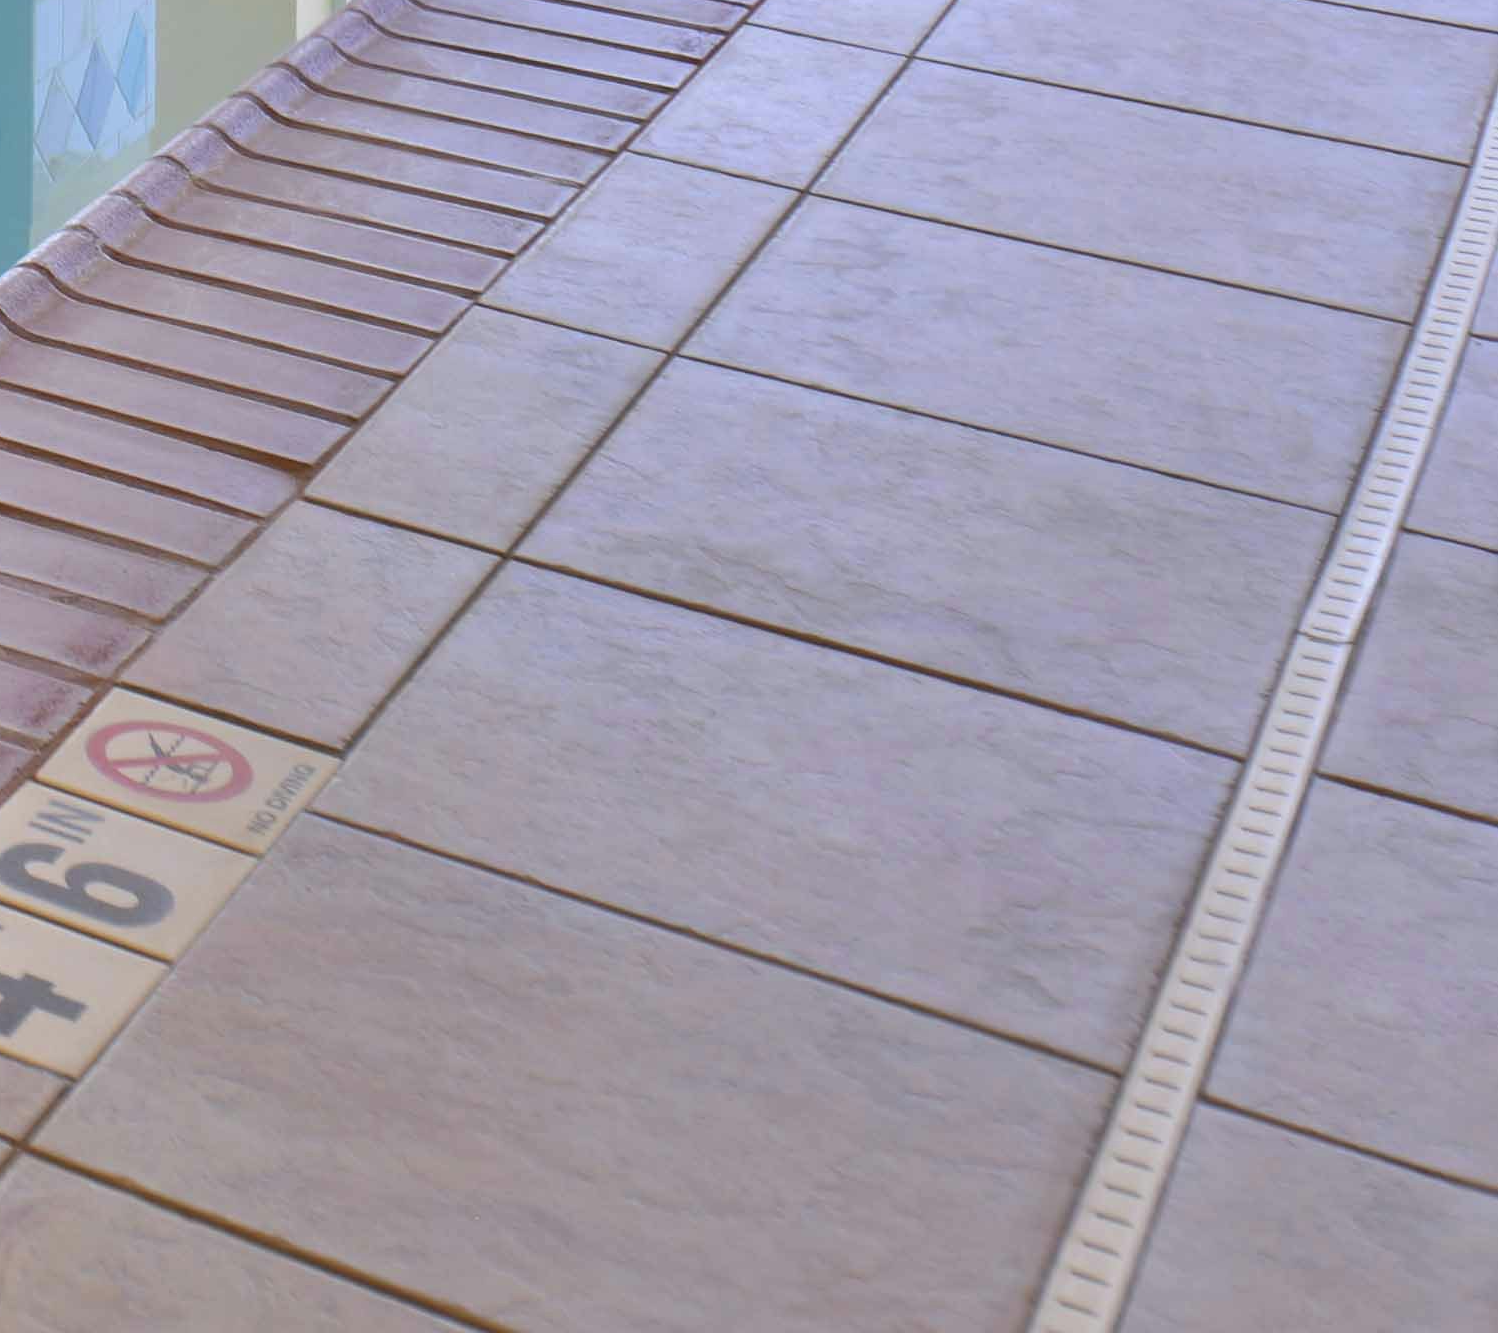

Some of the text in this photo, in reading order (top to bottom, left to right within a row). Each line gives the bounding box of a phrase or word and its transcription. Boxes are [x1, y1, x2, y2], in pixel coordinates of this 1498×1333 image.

[28, 799, 106, 845] IN
[247, 764, 317, 835] NO DIVING
